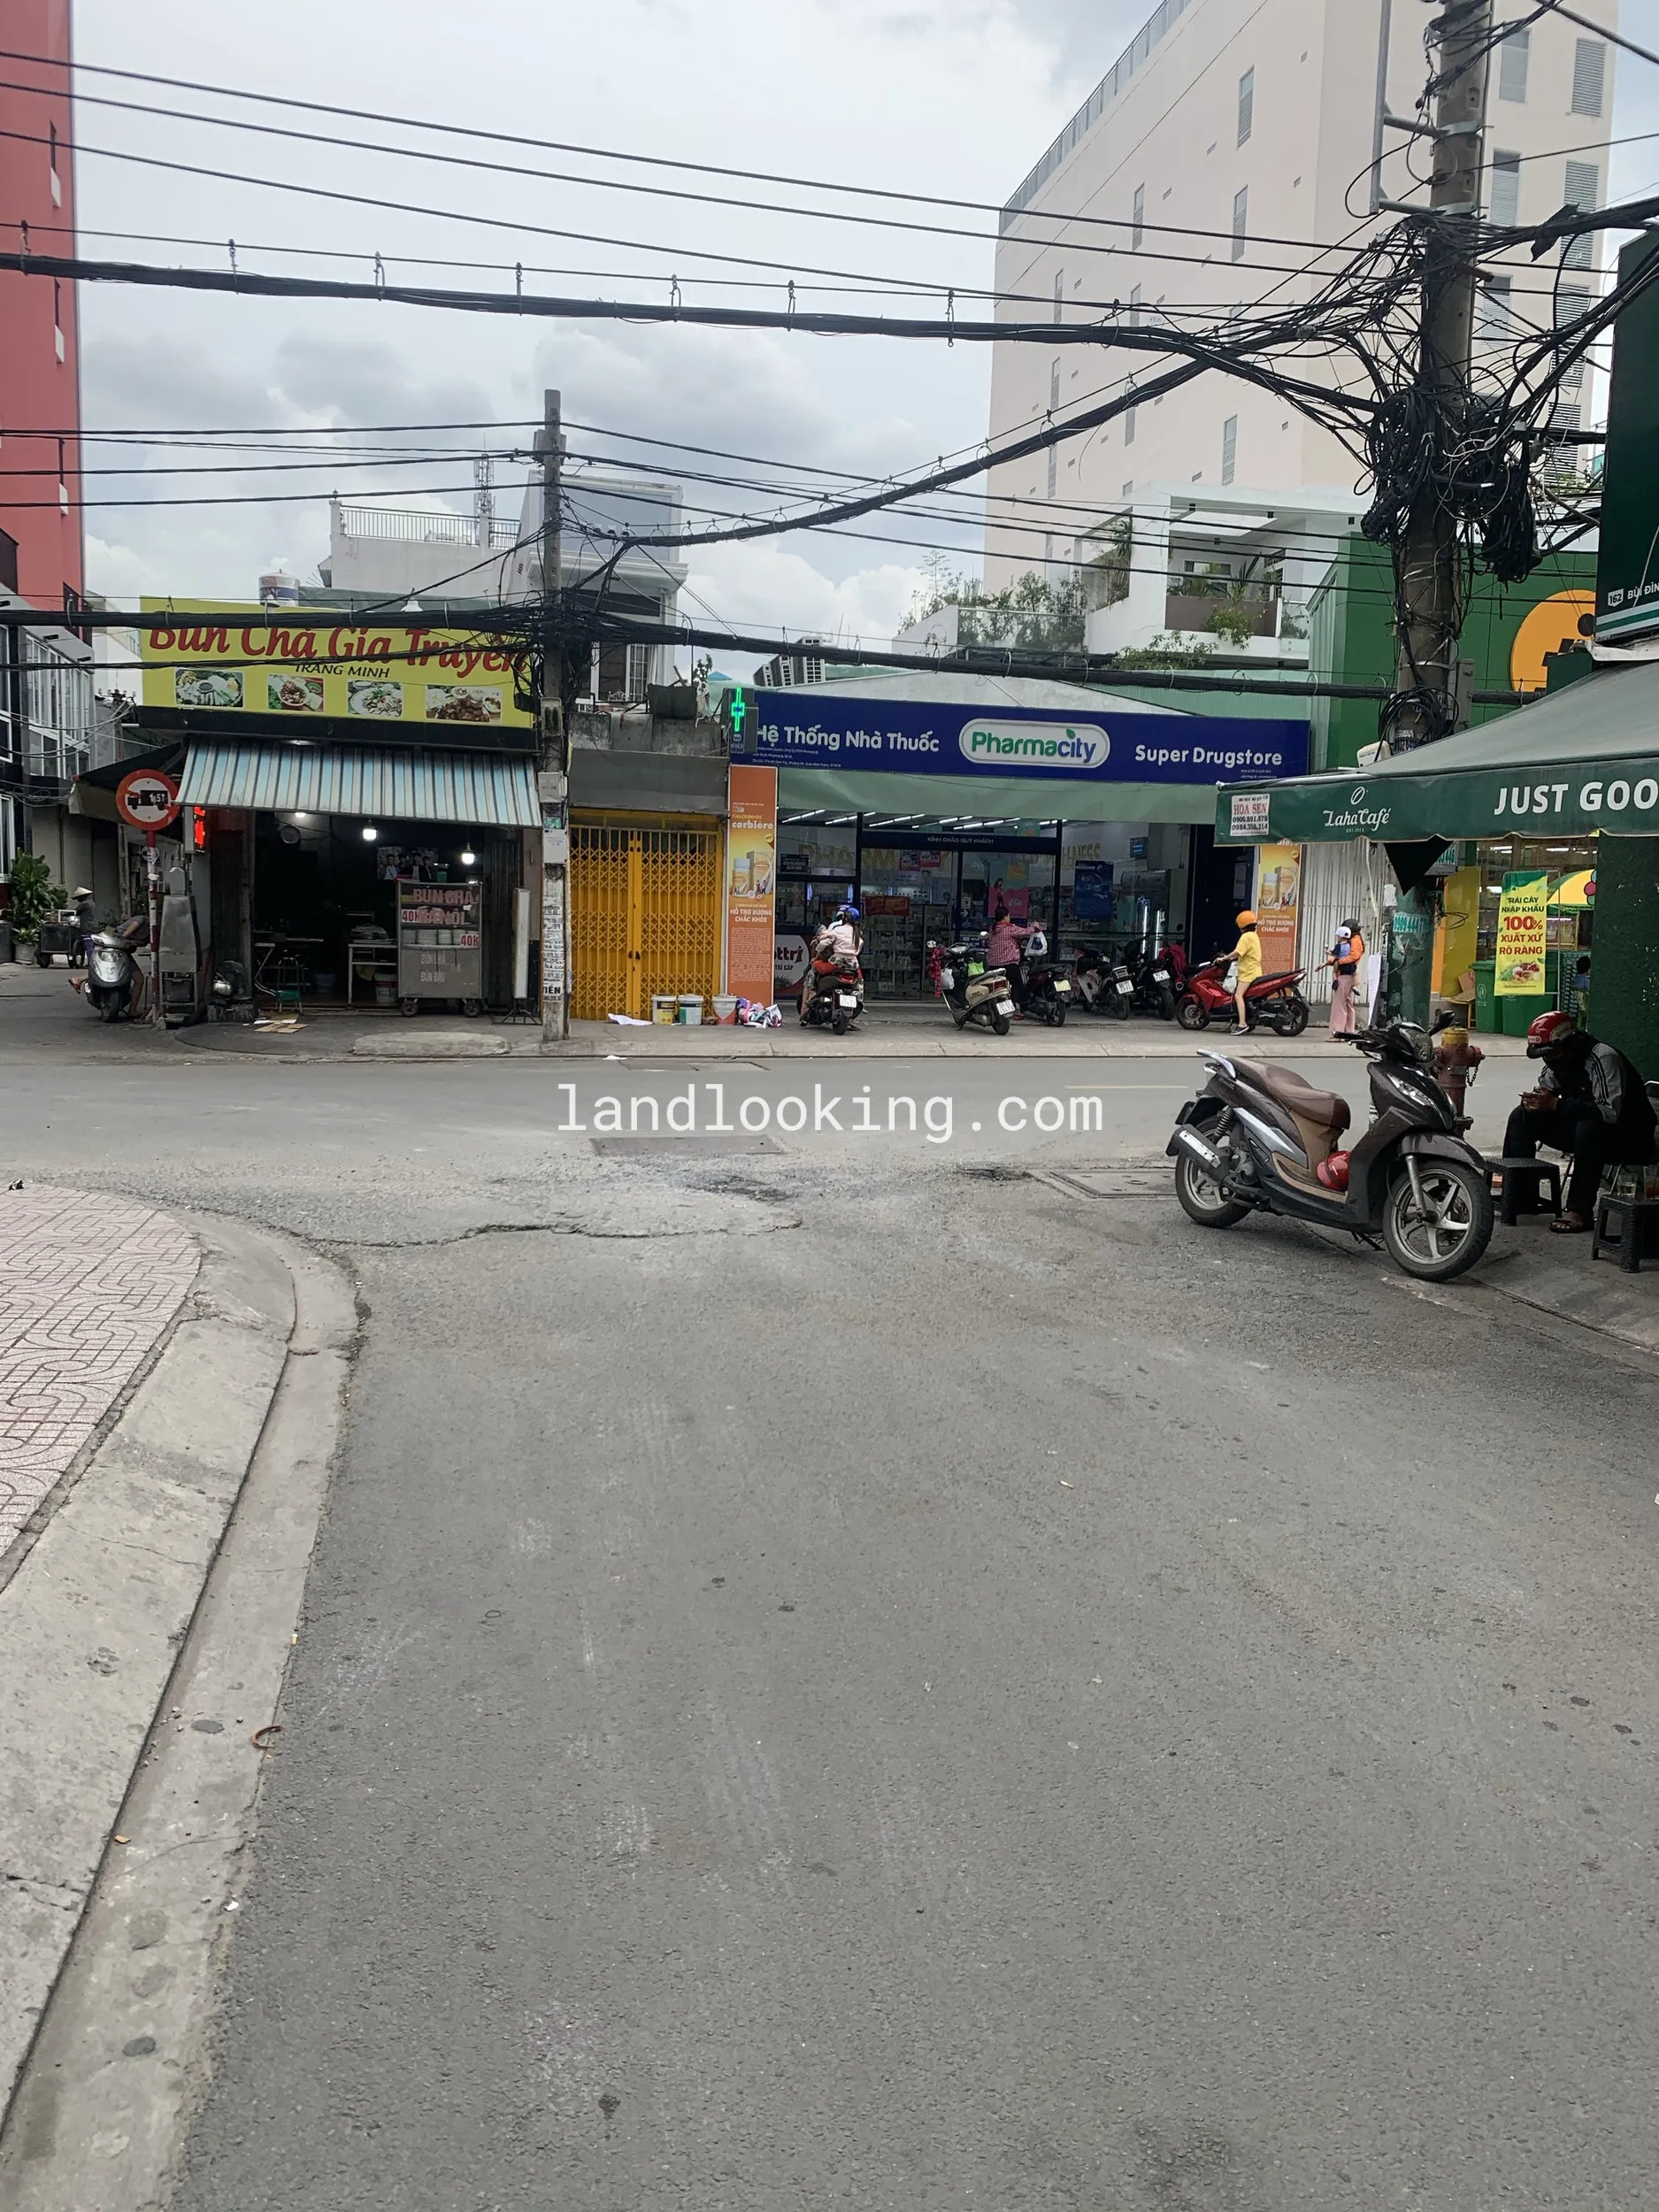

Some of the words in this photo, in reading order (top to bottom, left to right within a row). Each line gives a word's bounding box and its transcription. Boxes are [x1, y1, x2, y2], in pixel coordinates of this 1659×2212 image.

[1609, 594, 1622, 604] 162
[328, 626, 391, 664] Gia
[348, 667, 389, 678] MINH
[784, 724, 841, 751] Thống
[845, 730, 882, 749] Nhà
[887, 730, 940, 752] Thuốc
[972, 730, 1097, 764] Pharmacity
[1135, 744, 1189, 766] Super
[1193, 747, 1282, 769] Drugstore
[1494, 783, 1569, 816] JUST
[1579, 779, 1659, 811] GOO
[1233, 804, 1249, 815] HOA
[1252, 803, 1268, 814] SEN
[1502, 905, 1520, 914] NHẬP
[1522, 903, 1544, 913] KHẨU
[1503, 916, 1543, 931] 100%
[1501, 932, 1526, 942] XUẤT
[1527, 933, 1544, 942] XỨ
[1514, 945, 1543, 955] RÀNG
